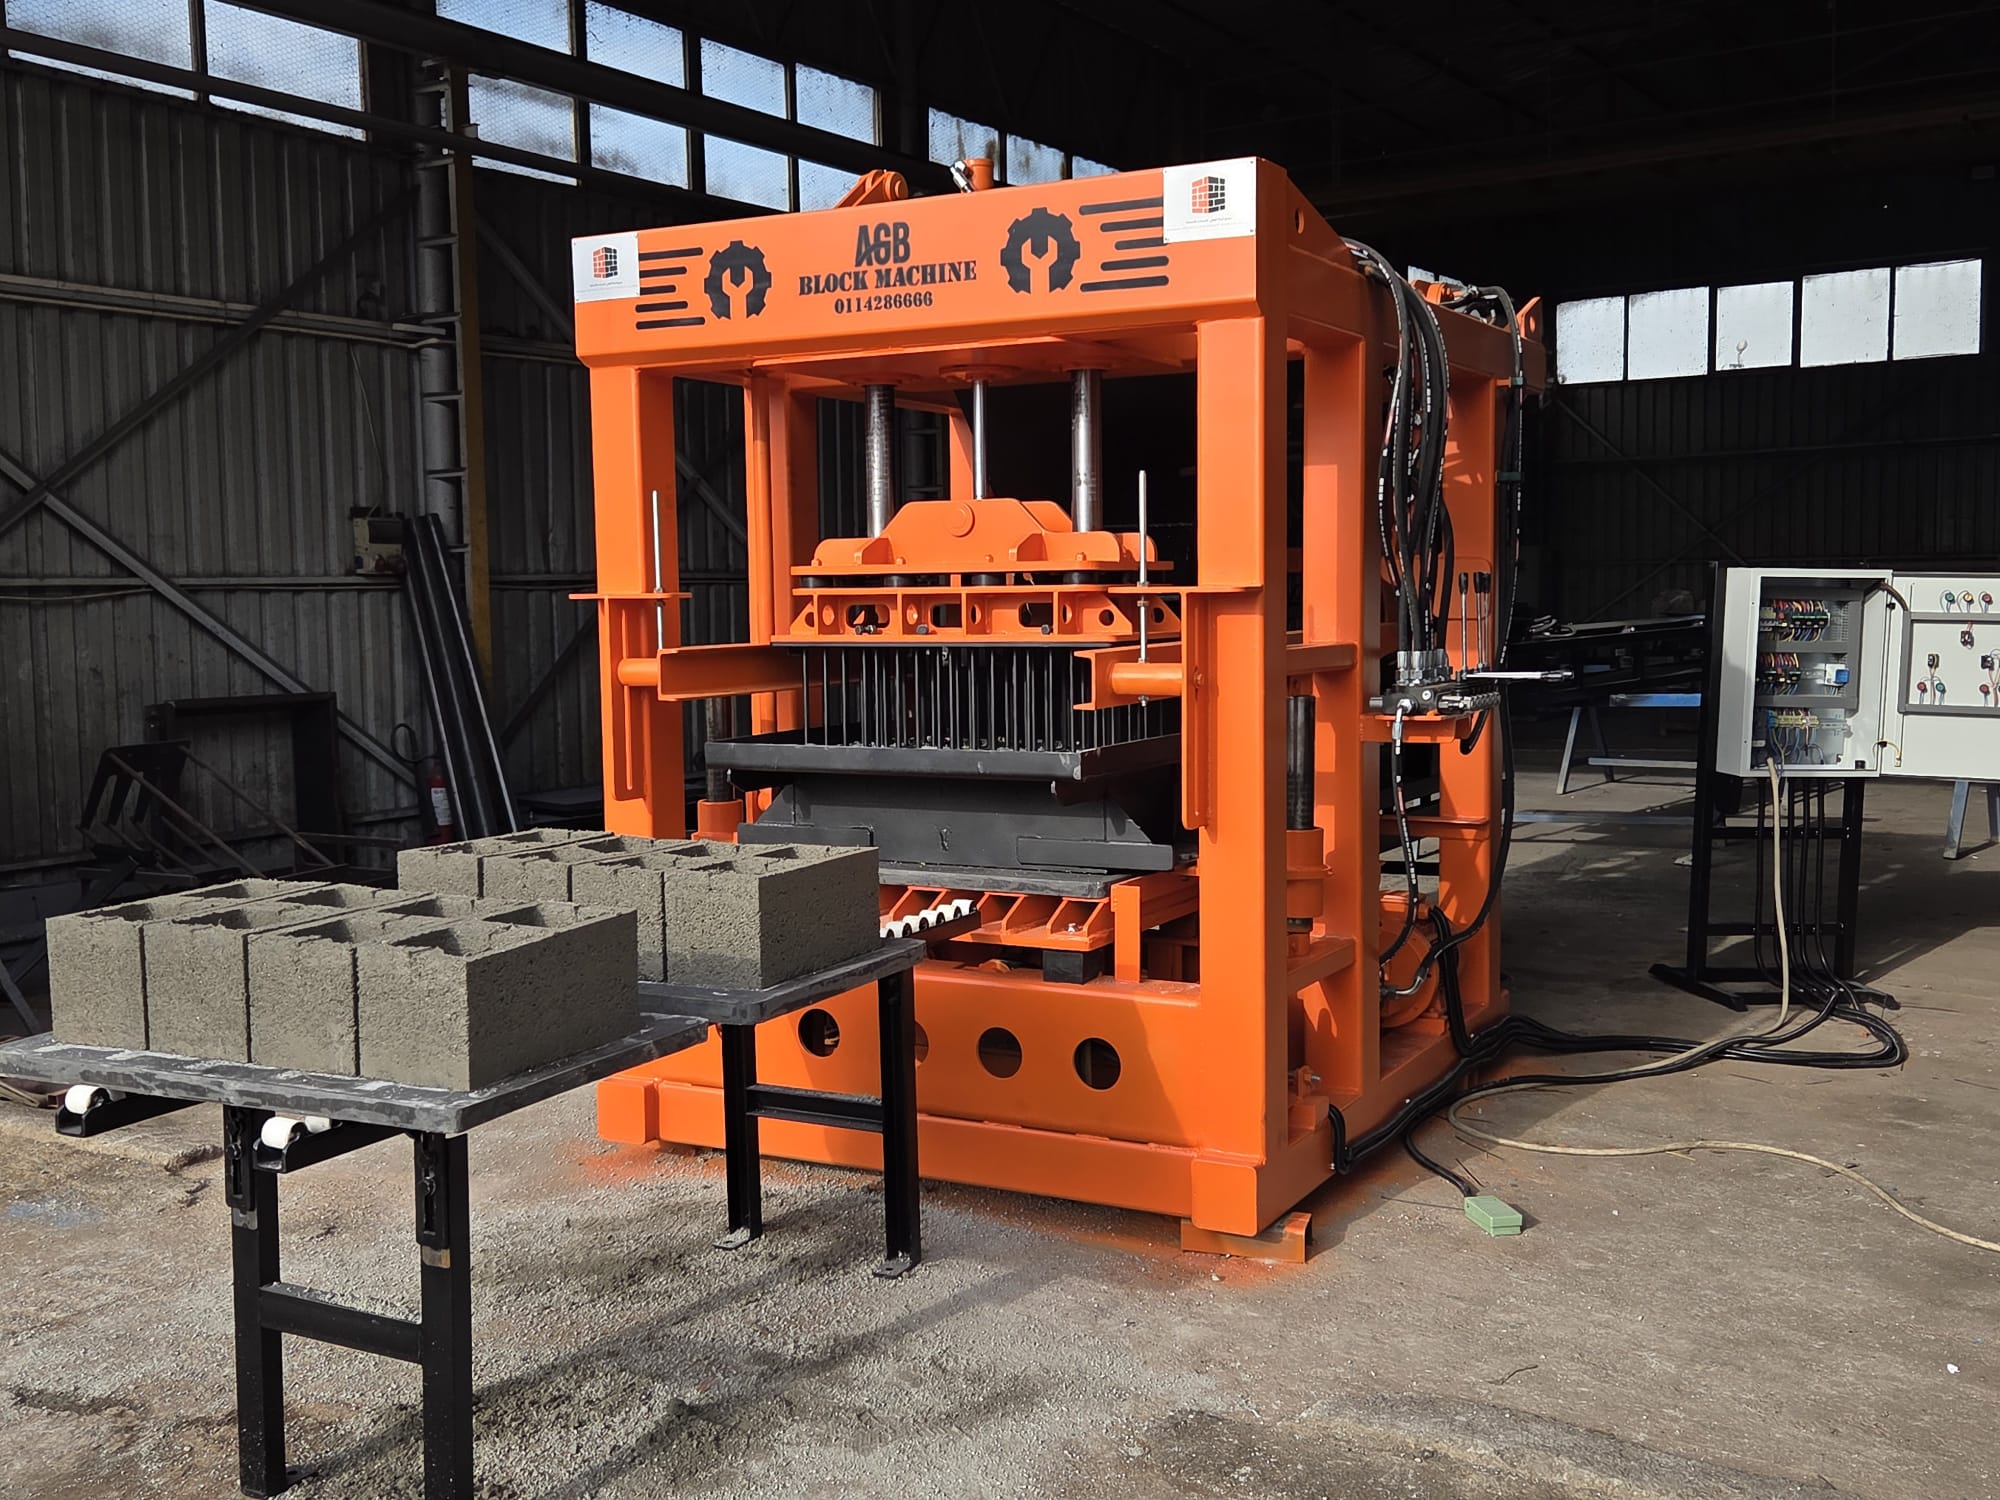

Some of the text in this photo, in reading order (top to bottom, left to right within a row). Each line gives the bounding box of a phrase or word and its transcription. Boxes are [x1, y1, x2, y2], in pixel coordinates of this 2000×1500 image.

[855, 222, 910, 267] AGB
[799, 260, 977, 296] BLOCK MACHINE
[834, 291, 933, 314] 0114286666
